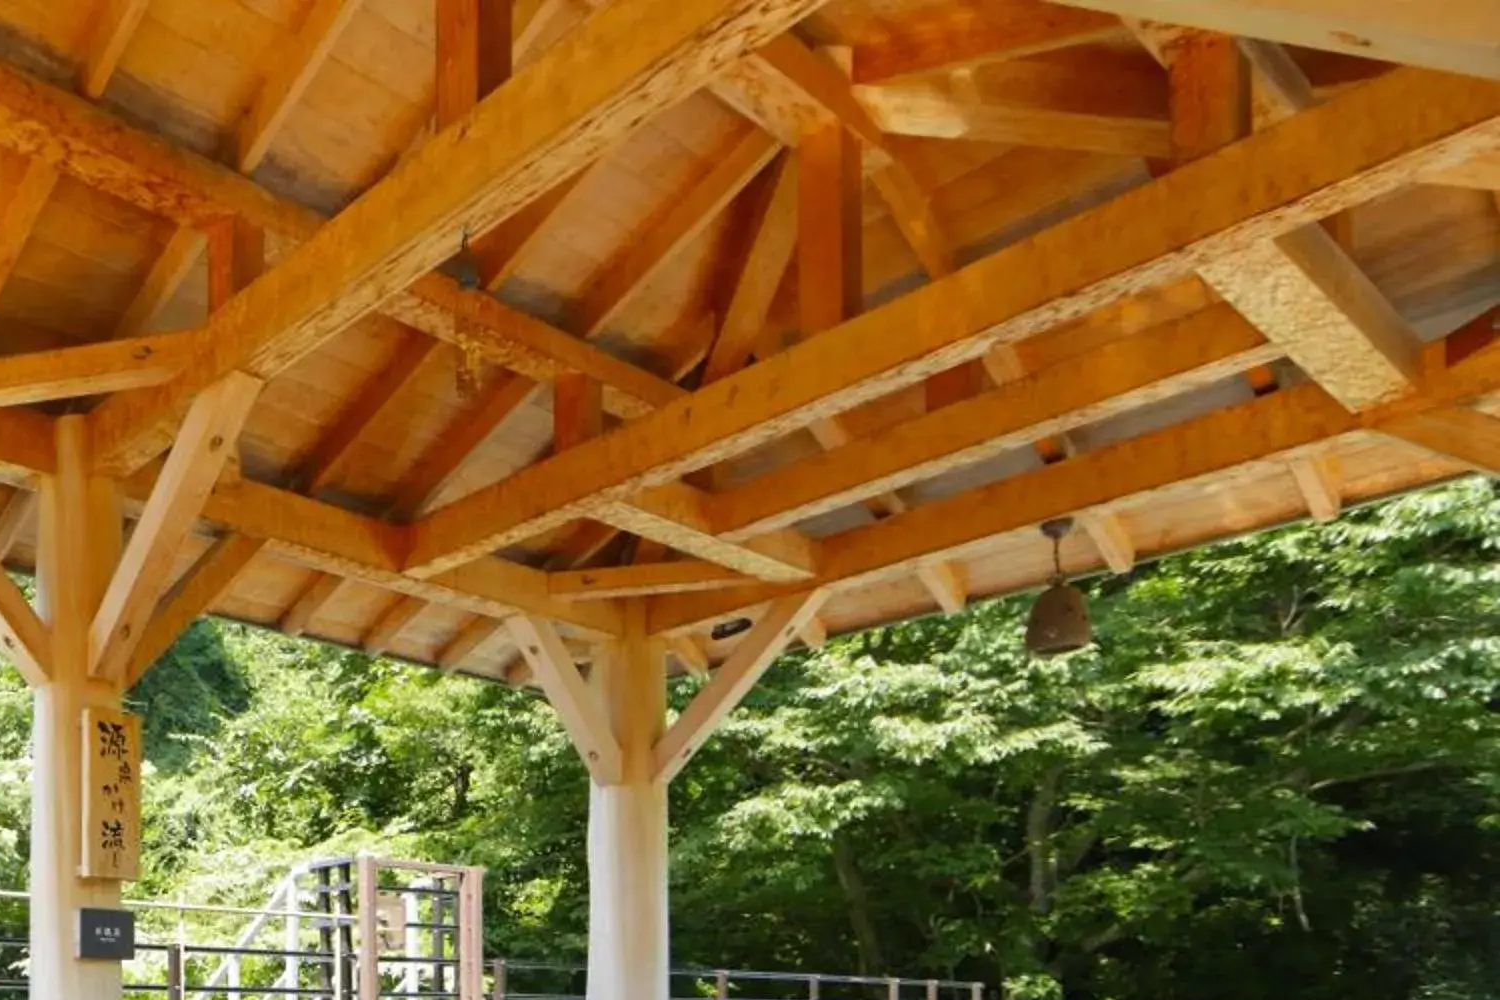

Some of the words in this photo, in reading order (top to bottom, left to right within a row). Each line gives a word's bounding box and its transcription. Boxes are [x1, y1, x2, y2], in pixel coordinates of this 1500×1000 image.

[97, 720, 132, 869] 源泉かけ流し
